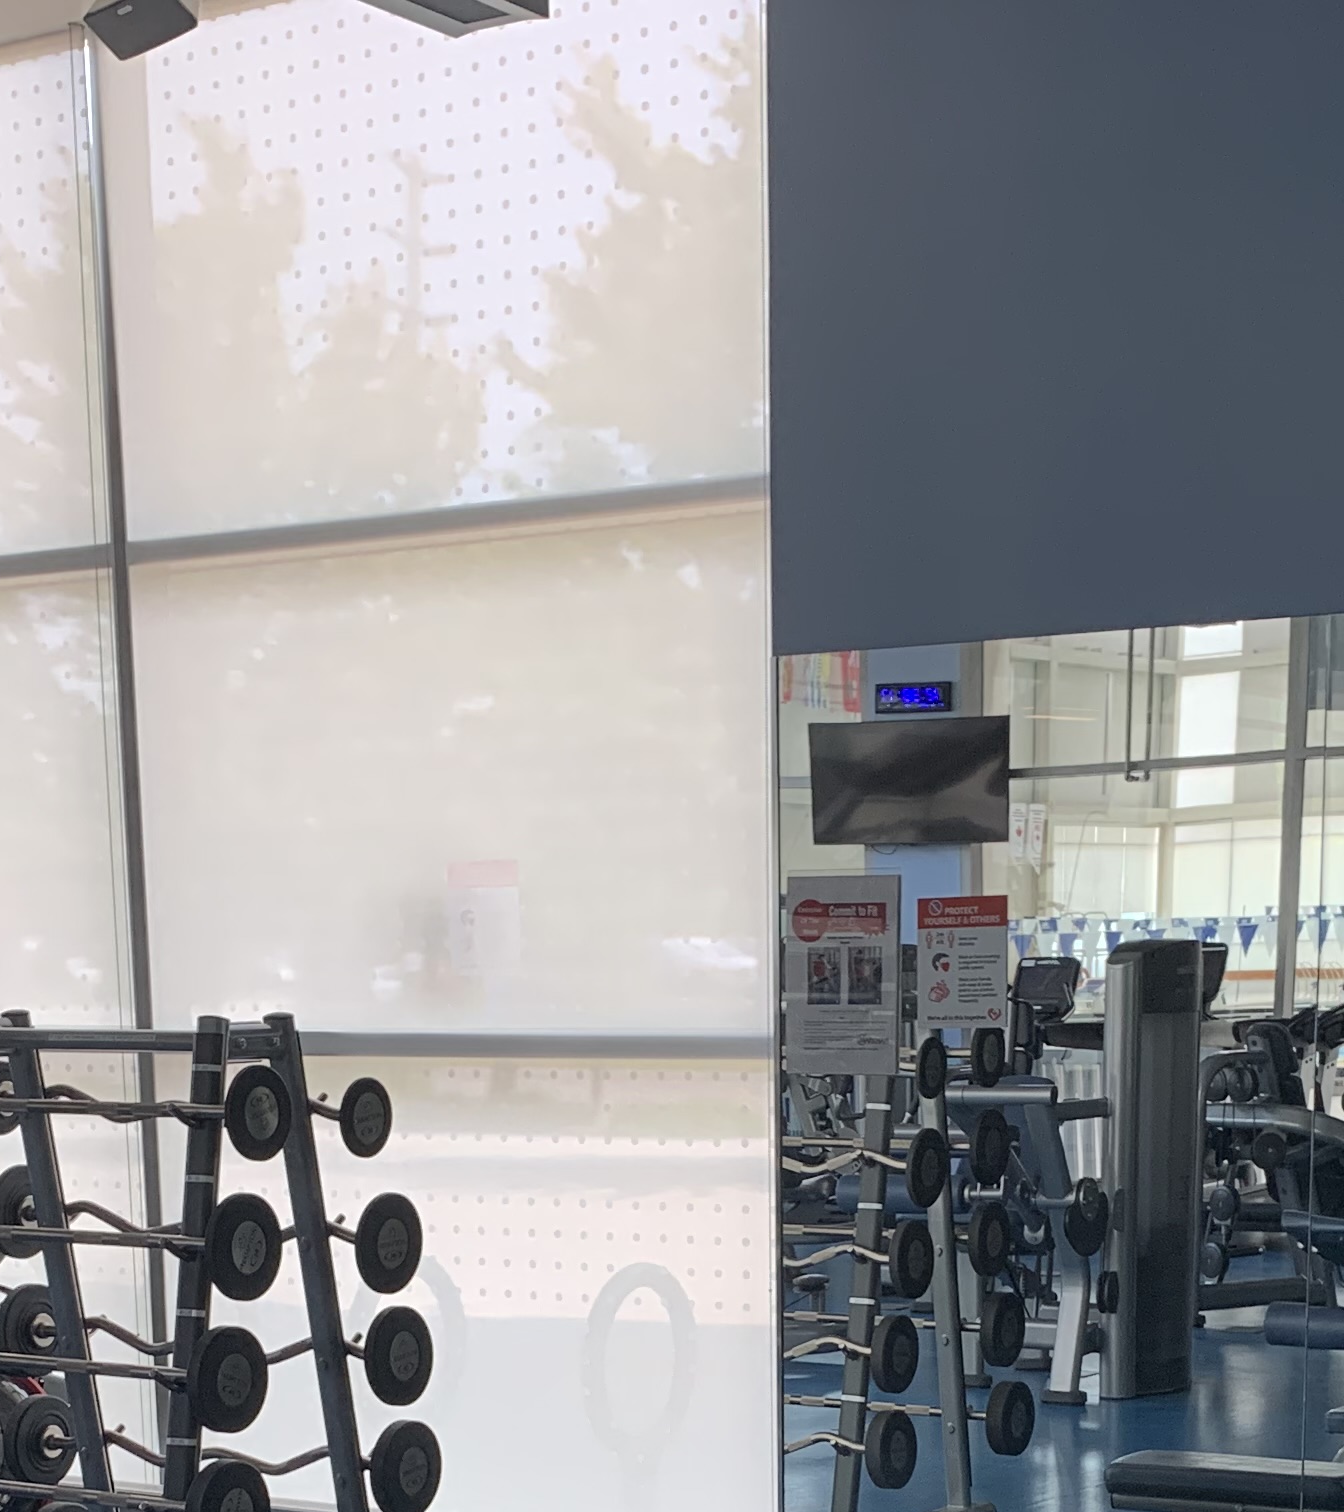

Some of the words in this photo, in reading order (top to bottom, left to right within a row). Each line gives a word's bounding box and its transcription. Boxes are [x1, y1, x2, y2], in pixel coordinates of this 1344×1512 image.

[828, 906, 857, 917] Commit
[858, 906, 866, 917] to
[867, 905, 879, 916] Fit
[944, 906, 978, 915] PROTECT
[924, 917, 962, 926] YOURSELF
[970, 915, 1000, 924] OTHERS
